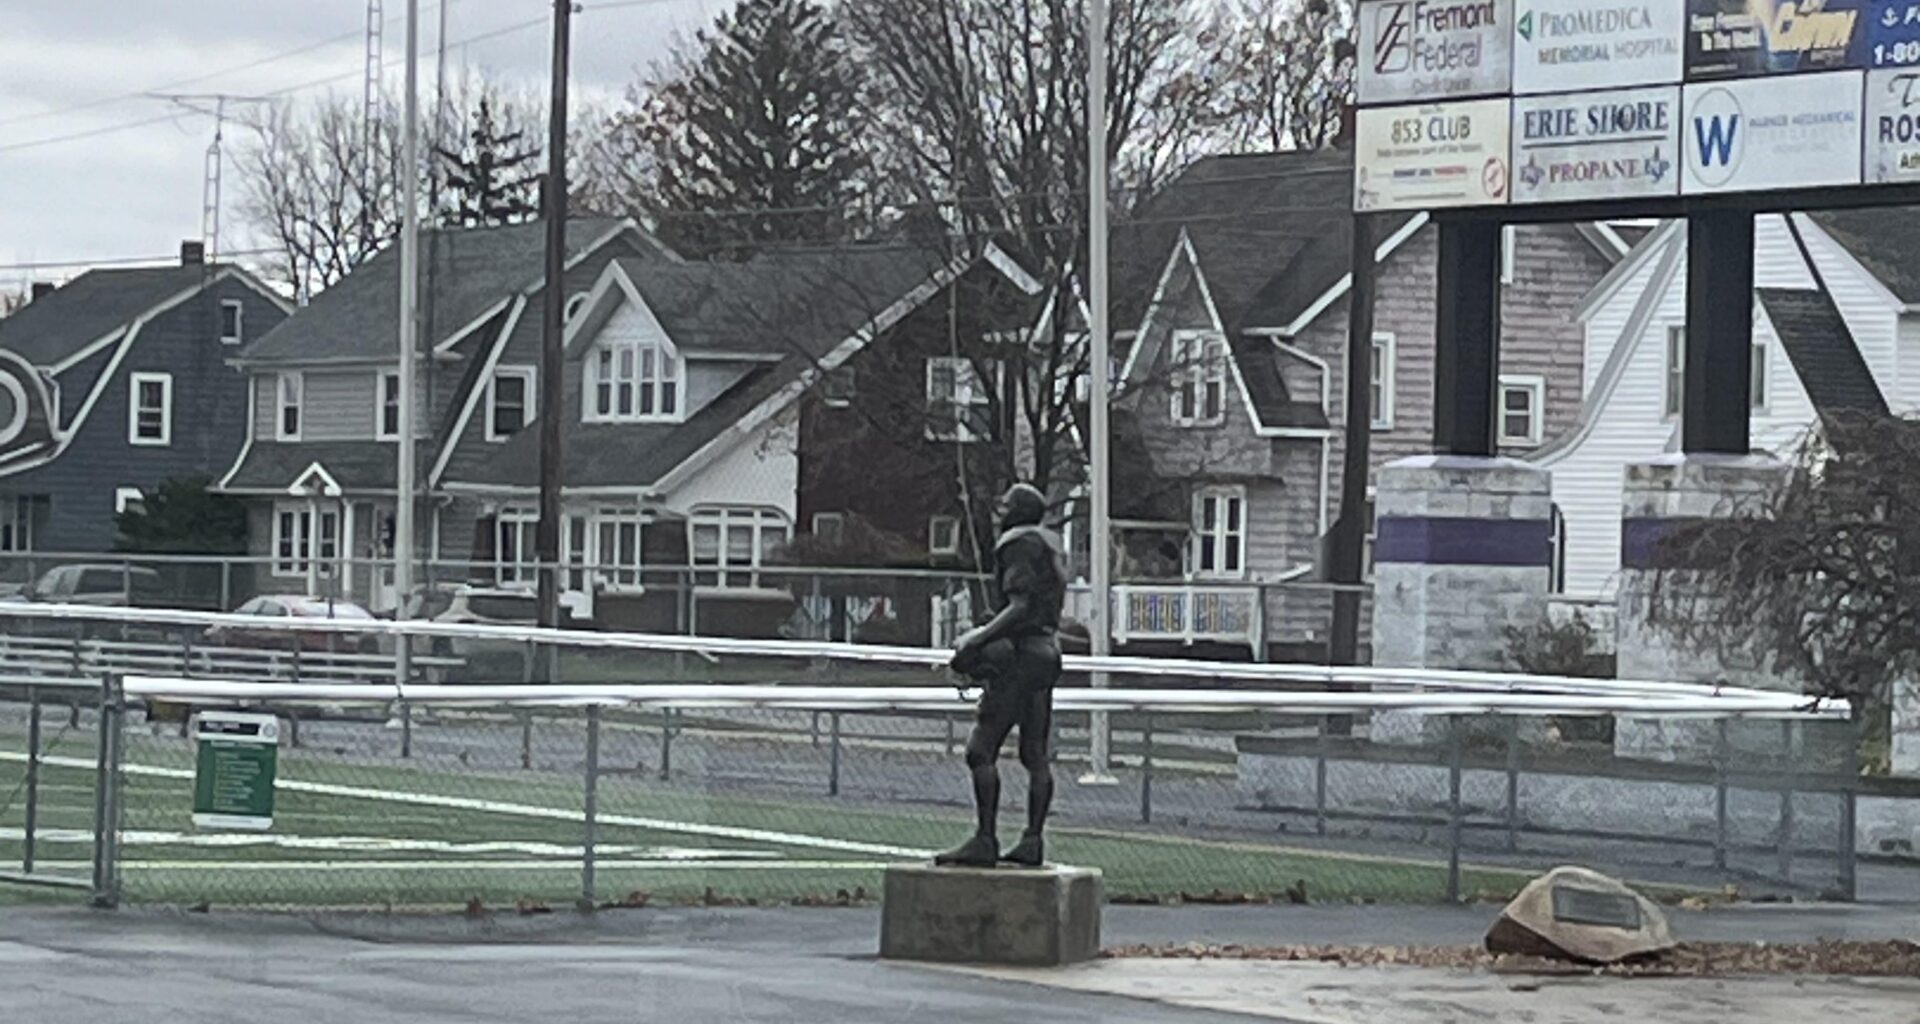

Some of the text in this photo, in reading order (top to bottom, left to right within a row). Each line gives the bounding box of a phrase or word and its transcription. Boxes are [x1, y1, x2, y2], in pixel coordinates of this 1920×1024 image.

[1414, 0, 1496, 33] Fremont
[1412, 34, 1482, 72] Federal
[1538, 43, 1610, 64] MEMORIAL
[1614, 37, 1679, 59] HOSPITAL
[1391, 115, 1471, 144] 853 CLUB
[1523, 101, 1669, 140] ERIE SHORE
[1694, 113, 1739, 167] W
[1550, 158, 1639, 184] PROPANE
